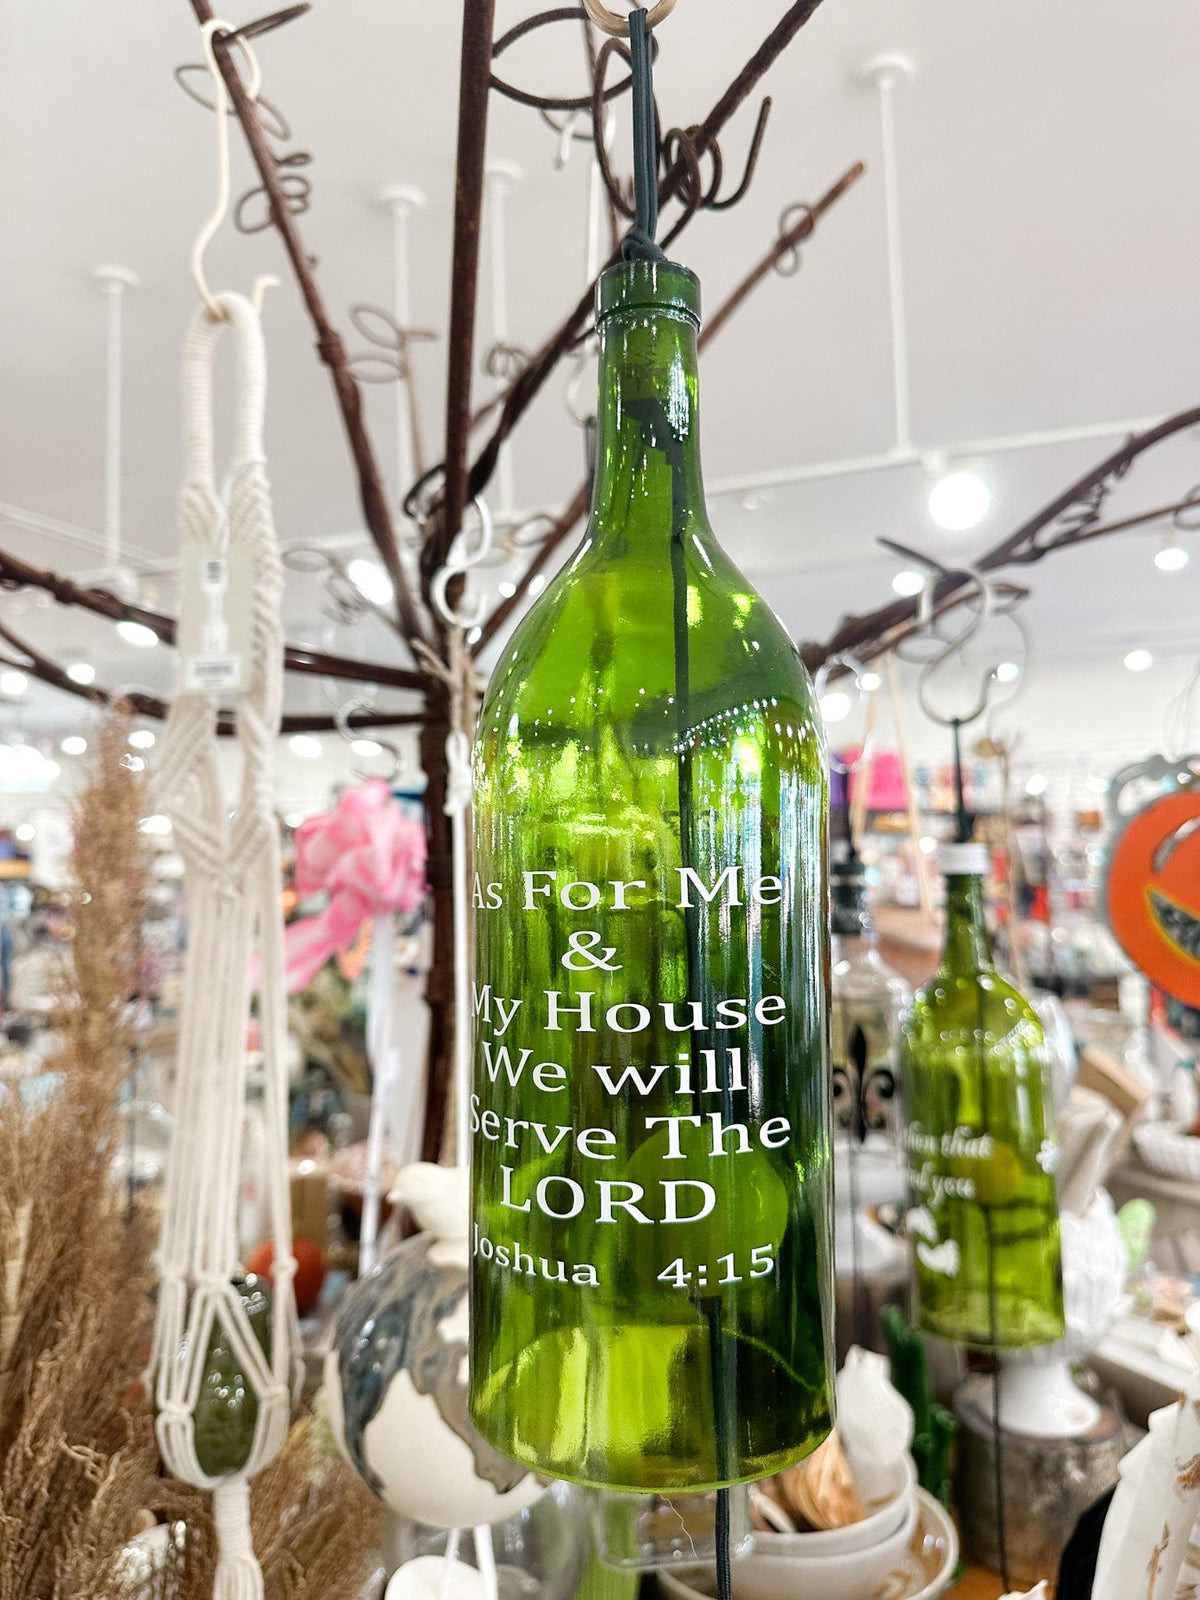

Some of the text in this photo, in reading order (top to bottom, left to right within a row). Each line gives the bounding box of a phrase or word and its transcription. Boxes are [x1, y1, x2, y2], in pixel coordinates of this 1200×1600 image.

[471, 865, 783, 910] As For Me
[561, 930, 623, 971] &
[471, 981, 787, 1036] My House
[482, 1041, 747, 1096] We will
[469, 1093, 791, 1160] Serve The
[500, 1164, 717, 1224] LORD
[473, 1222, 775, 1288] Joshua 4:15
